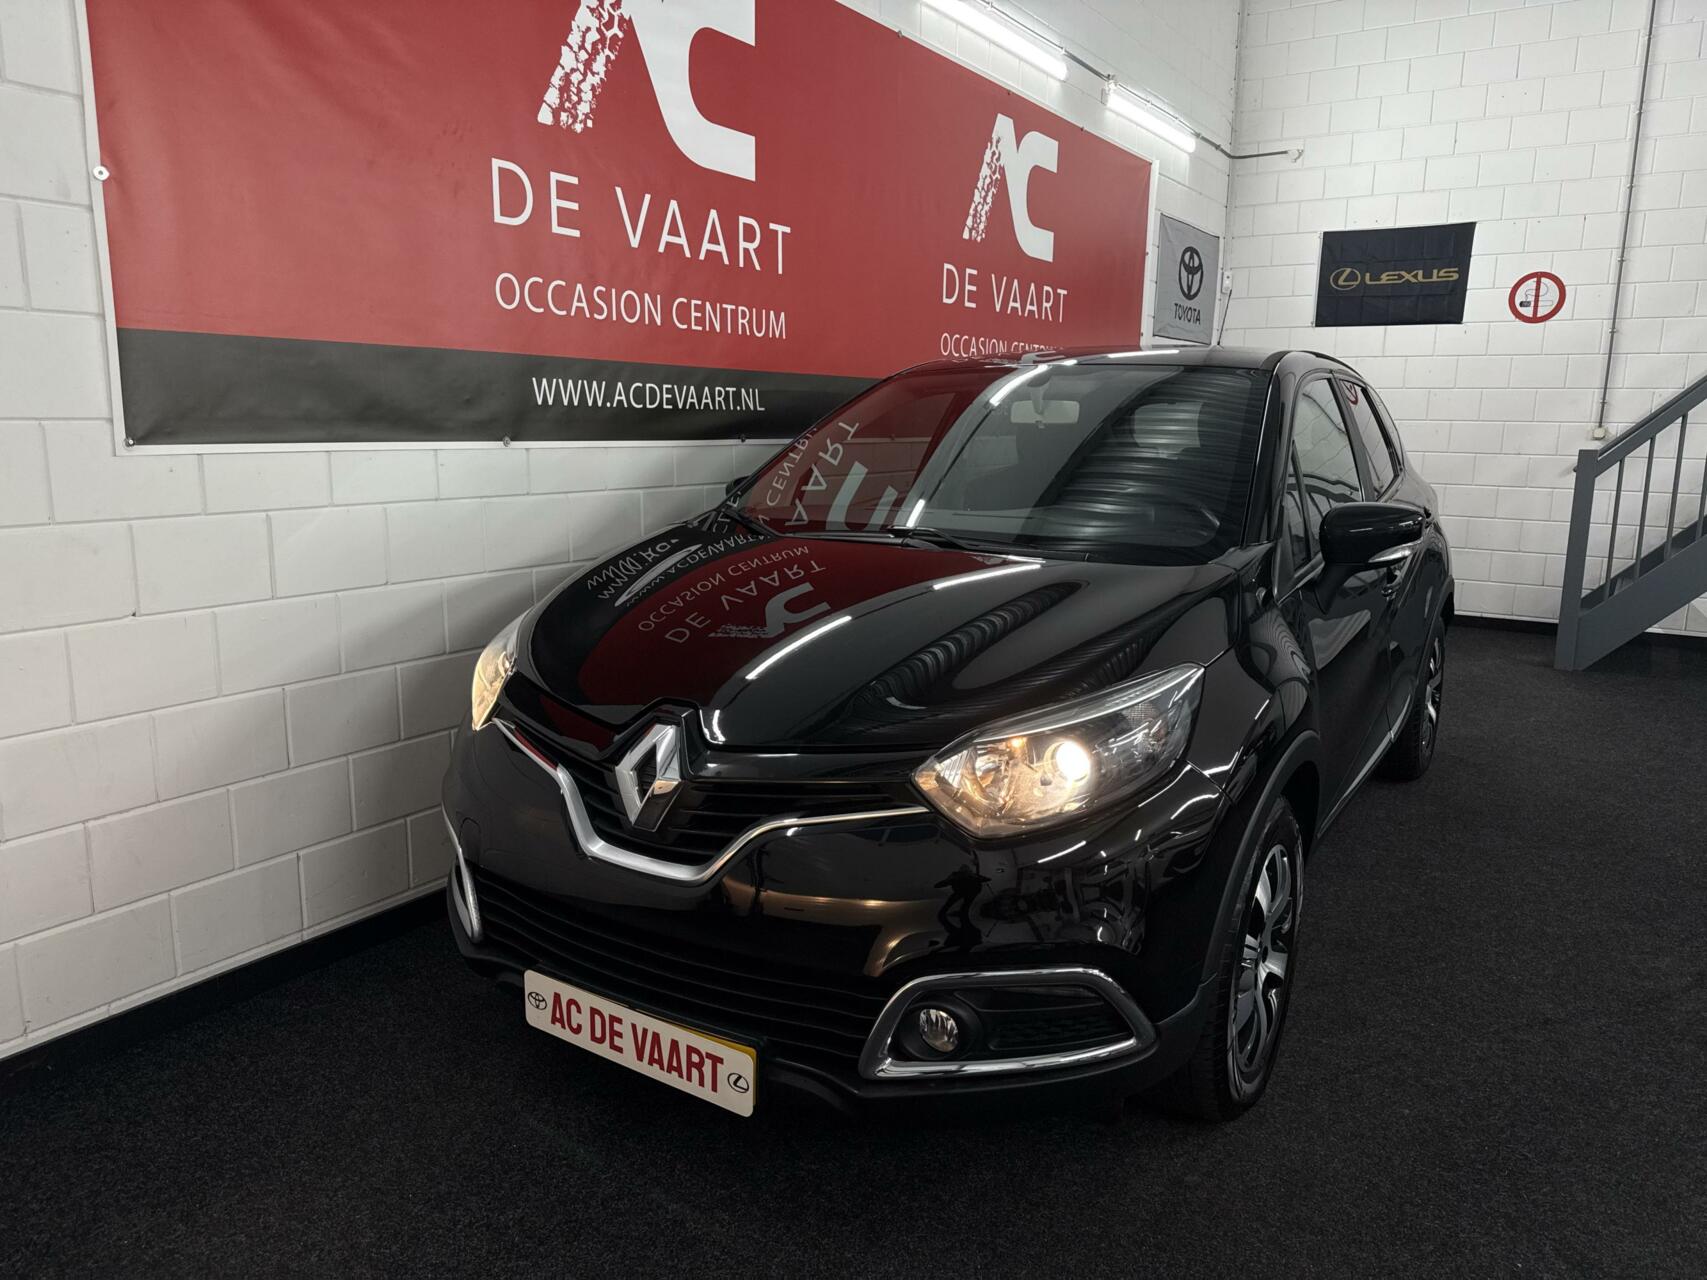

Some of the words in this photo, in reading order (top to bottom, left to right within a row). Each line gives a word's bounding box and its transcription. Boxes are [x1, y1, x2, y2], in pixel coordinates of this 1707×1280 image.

[491, 157, 581, 238] DE
[615, 186, 791, 275] VAART
[495, 272, 663, 326] OCCASION
[672, 297, 787, 339] CENTRUM
[942, 262, 978, 309] DE
[991, 273, 1068, 323] VAART
[1364, 268, 1460, 285] LEXUS
[1174, 302, 1201, 326] TOYOTA
[532, 376, 766, 412] WWW.ACDEVAART.NL
[550, 991, 582, 1036] AC
[589, 1006, 624, 1054] DE
[630, 1022, 724, 1093] VAART
